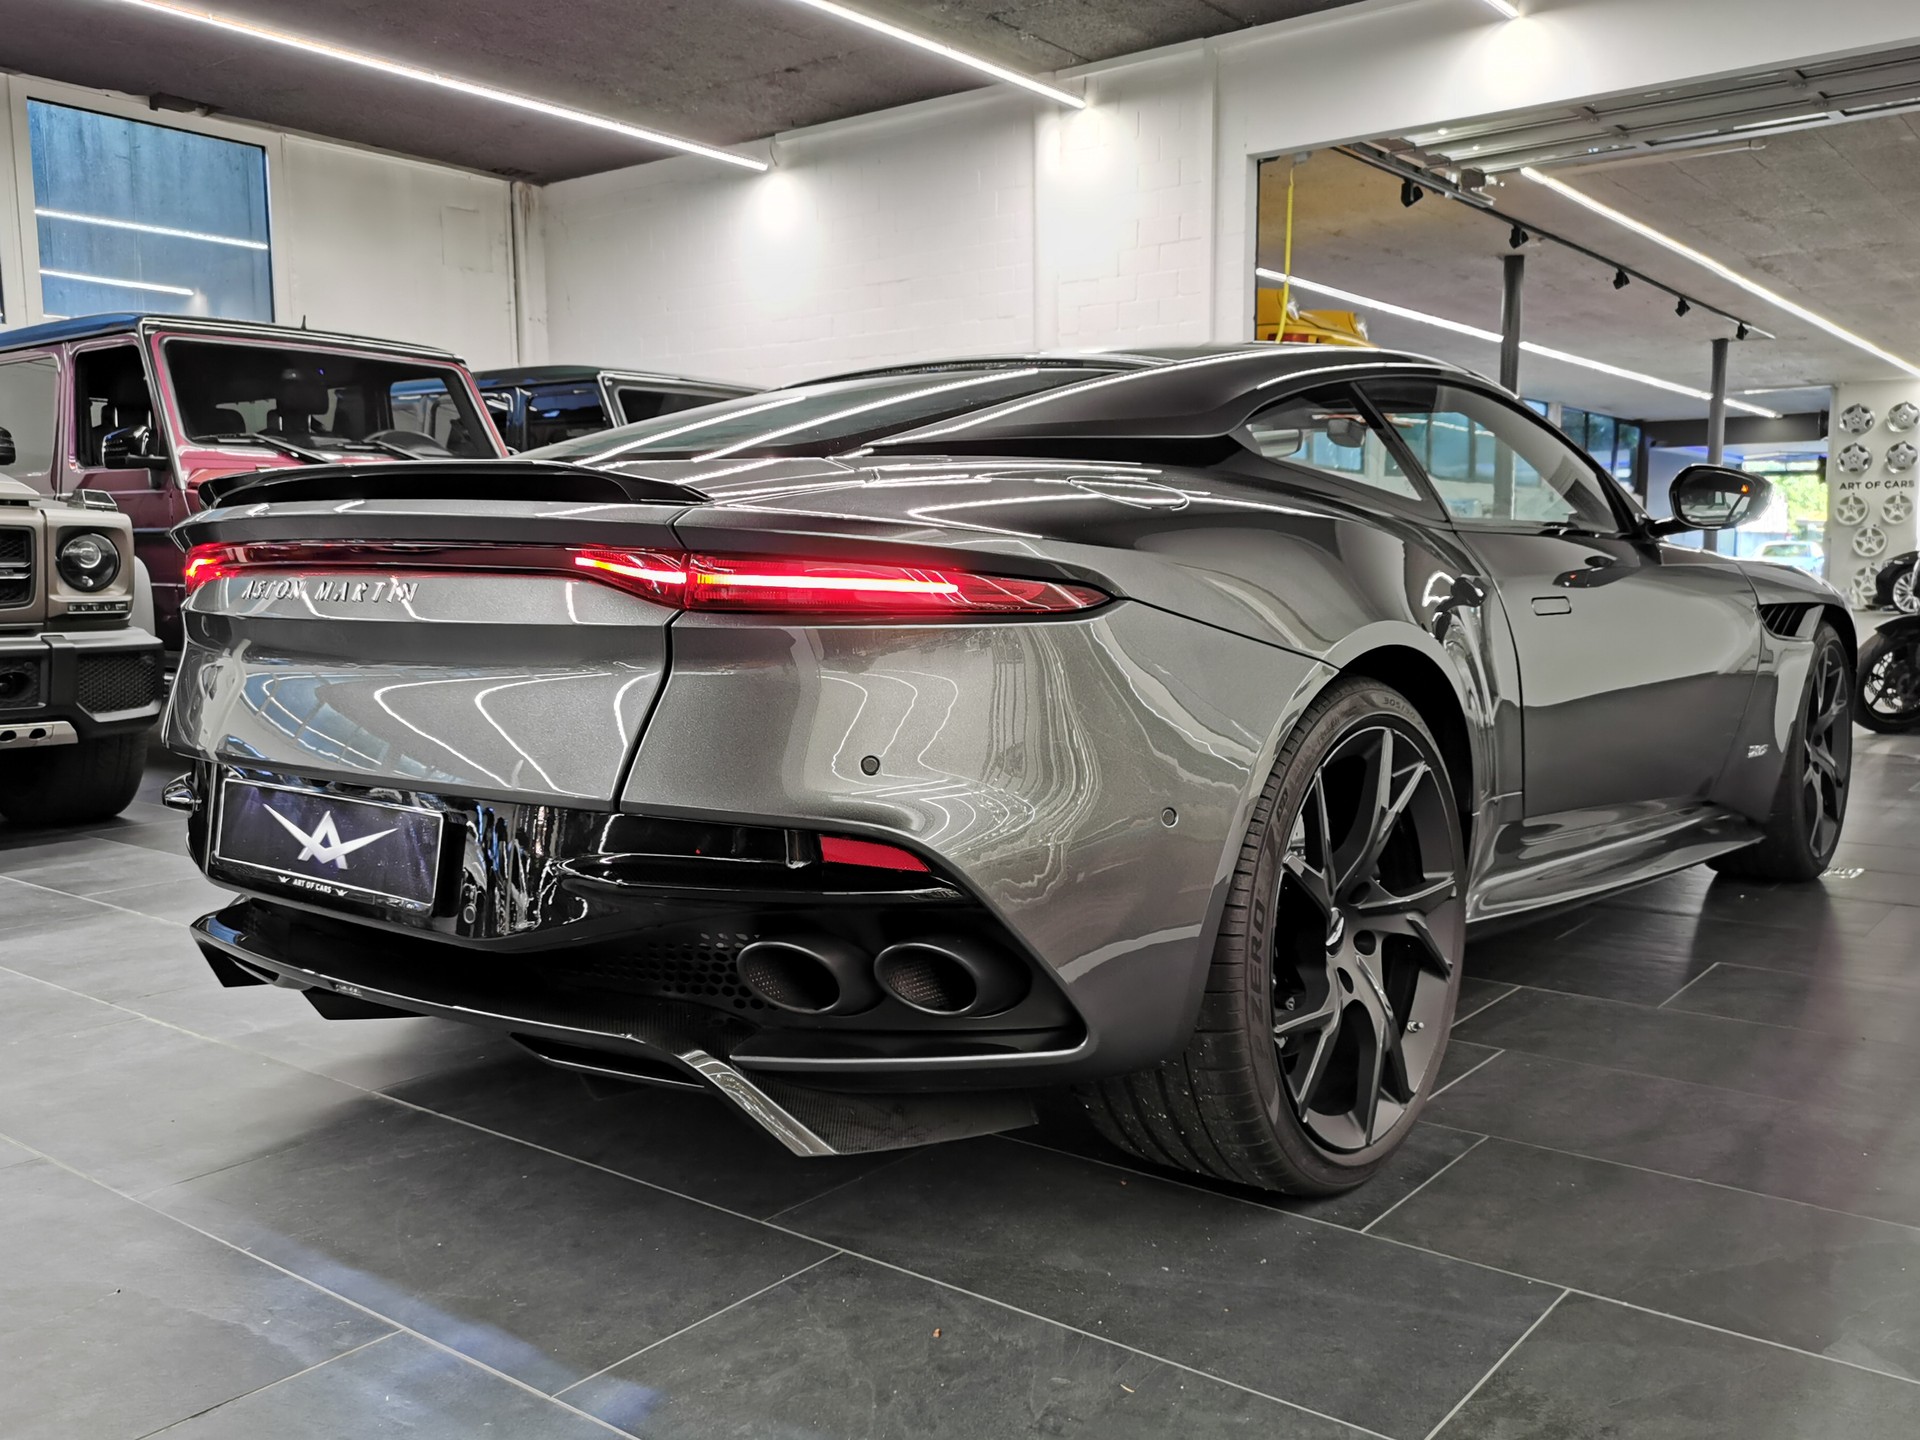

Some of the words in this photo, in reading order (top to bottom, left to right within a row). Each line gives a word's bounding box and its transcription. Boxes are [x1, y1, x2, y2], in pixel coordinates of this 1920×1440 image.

[1839, 481, 1861, 490] ART
[1865, 481, 1881, 490] OF
[1884, 480, 1915, 489] CARS
[241, 579, 306, 601] ASTON
[314, 580, 420, 603] MARTIN
[292, 878, 305, 888] ART
[305, 881, 315, 890] OF
[315, 883, 332, 894] CARS
[1249, 898, 1268, 1027] ZERO
